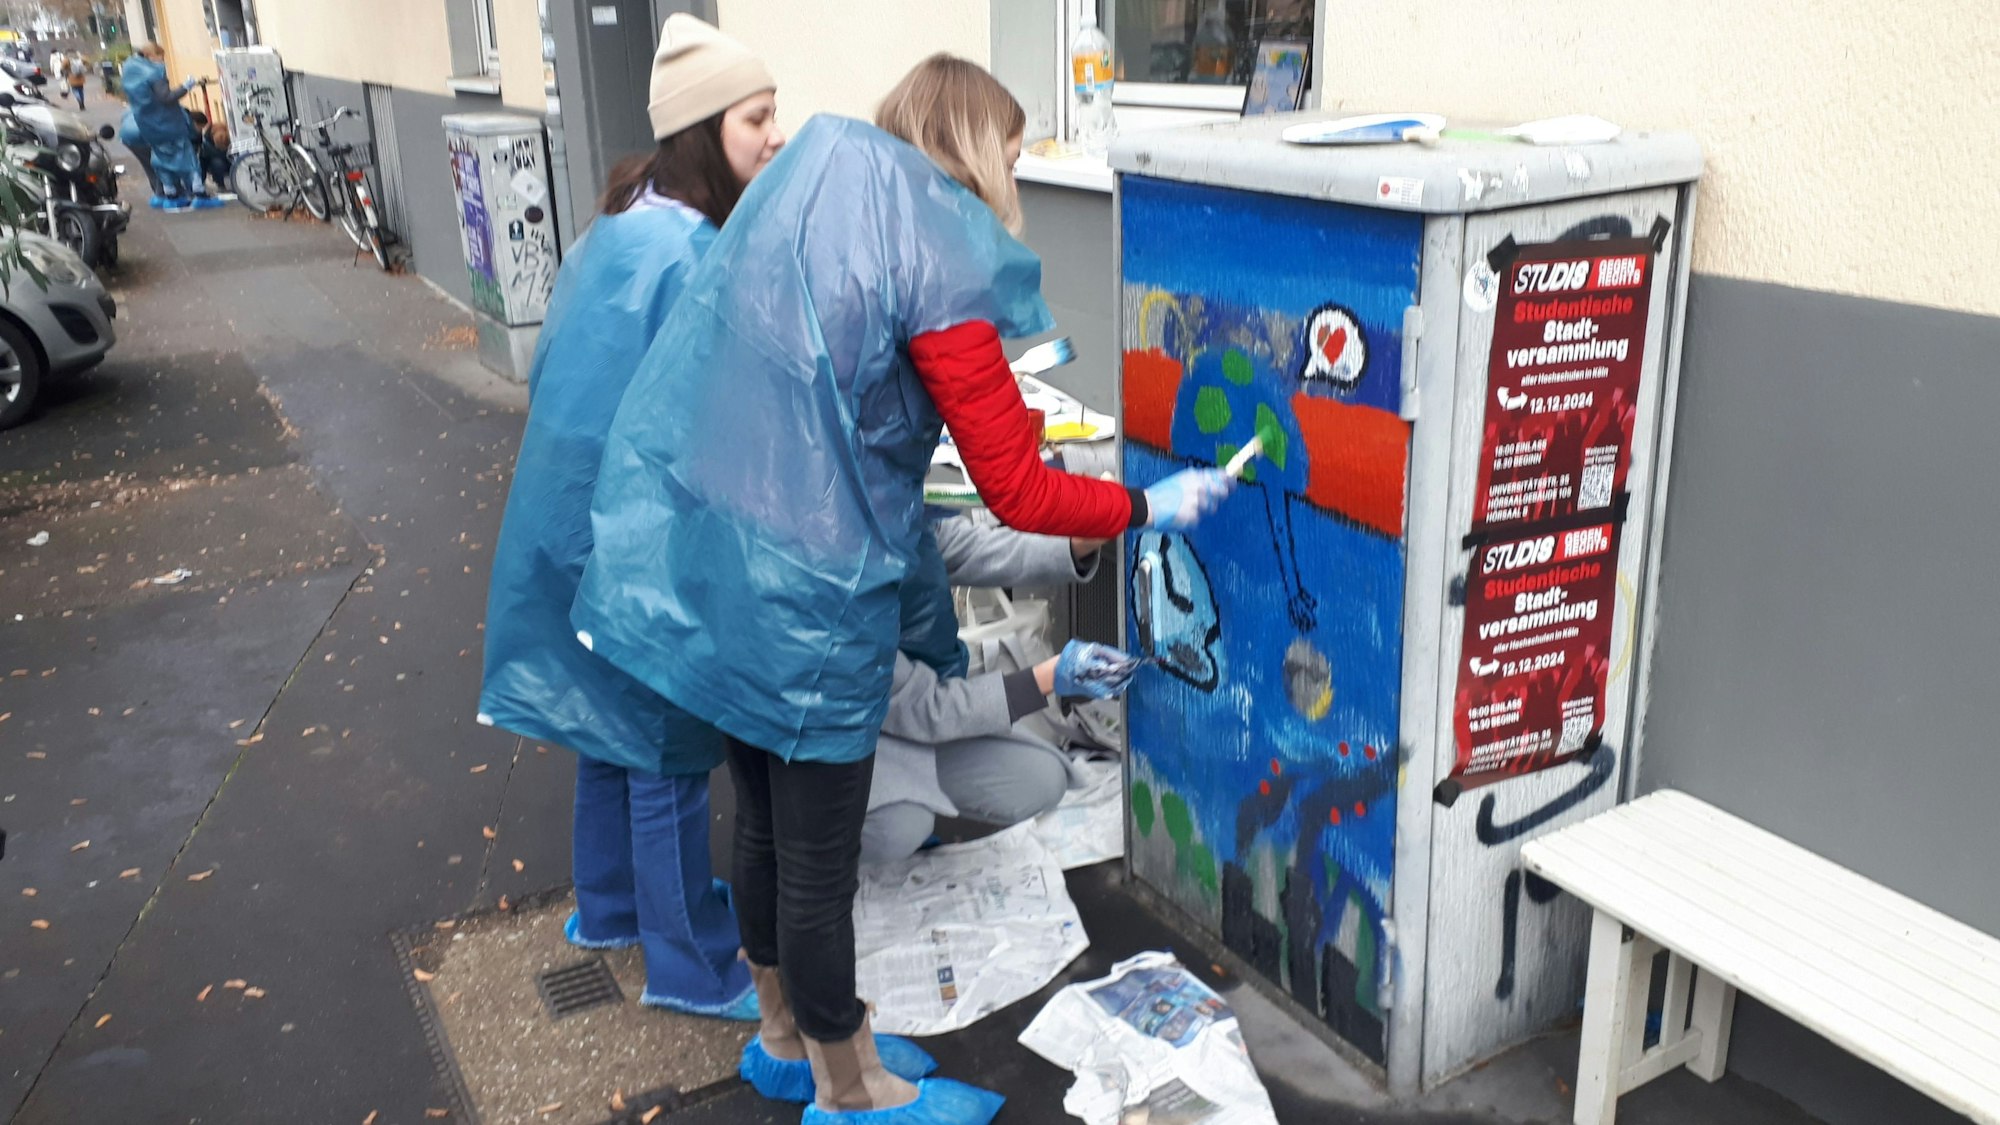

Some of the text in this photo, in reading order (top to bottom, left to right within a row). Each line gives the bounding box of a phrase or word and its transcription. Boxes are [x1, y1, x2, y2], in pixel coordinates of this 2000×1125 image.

[1599, 257, 1636, 273] GEGEN
[1514, 260, 1590, 294] STUDIS
[1598, 269, 1640, 288] RECHTS
[1514, 294, 1633, 324] Studentische
[1543, 317, 1599, 343] Stadt-
[1507, 338, 1629, 368] versammlung
[1521, 367, 1608, 387] aller Hochschulen in Köln
[1530, 392, 1593, 414] 12.12.2024
[1515, 439, 1547, 455] EINLASS
[1513, 453, 1542, 469] BEGINN
[1486, 508, 1521, 524] HÖRSAAL
[1564, 537, 1607, 558] RECHTS
[1565, 527, 1602, 546] GEGEN
[1483, 535, 1555, 574] STUDIS
[1484, 562, 1601, 600] Studentische
[1515, 586, 1568, 613] Stadt-
[1479, 599, 1598, 640] versammlung
[1493, 627, 1579, 654] aller Hochschulen in Köln
[1502, 650, 1565, 676] 12.12.2024
[1490, 698, 1522, 715] EINLASS
[1491, 711, 1520, 728] BEGINN
